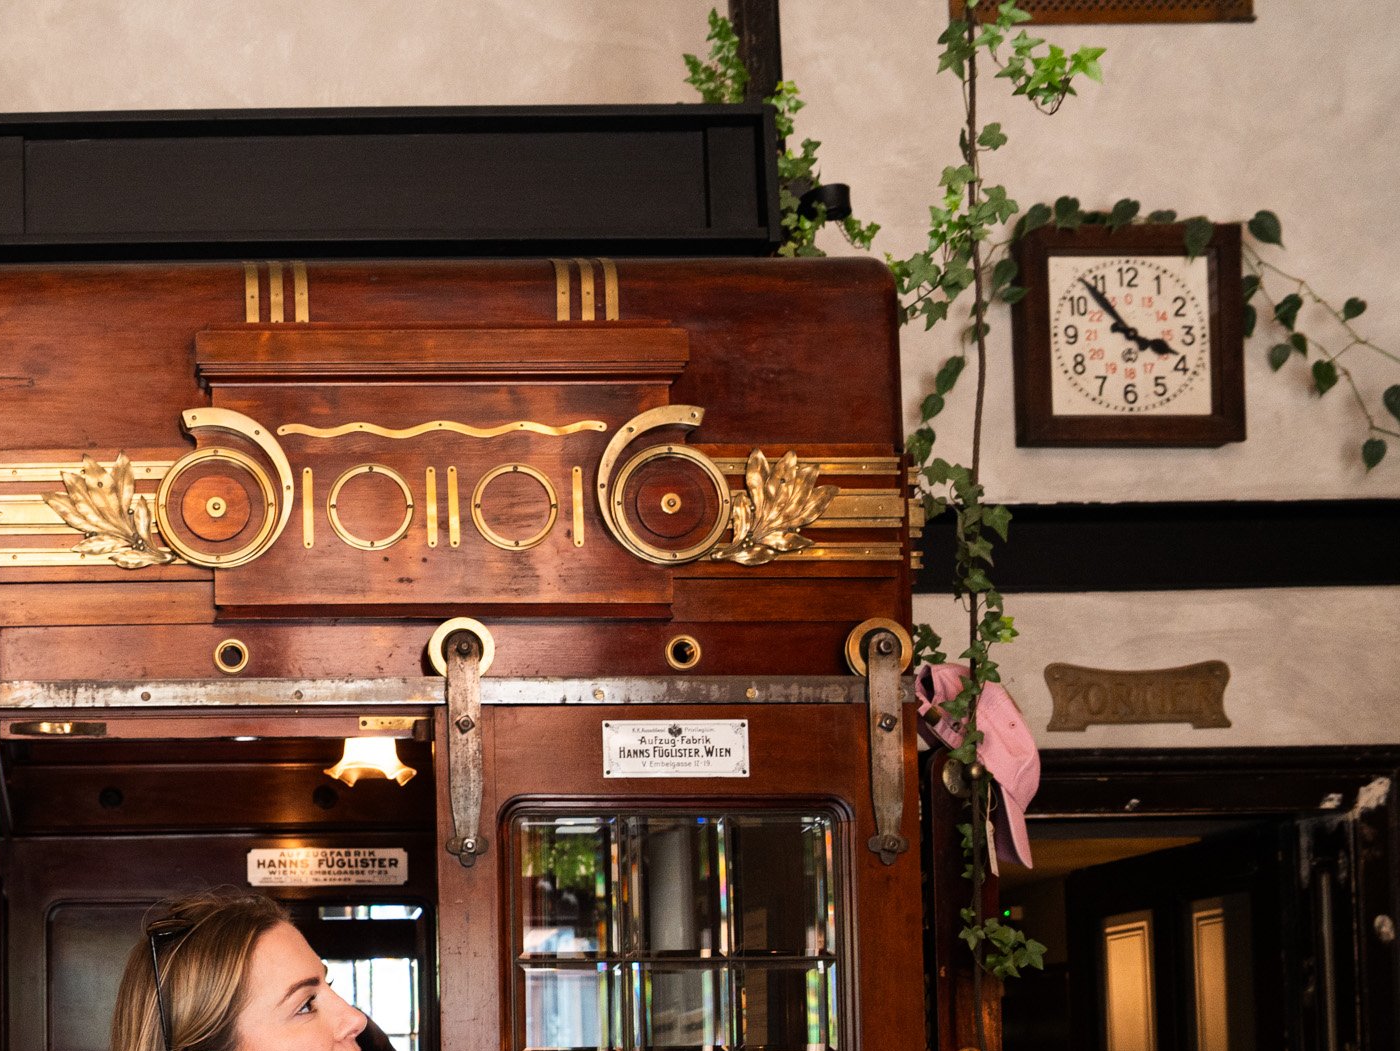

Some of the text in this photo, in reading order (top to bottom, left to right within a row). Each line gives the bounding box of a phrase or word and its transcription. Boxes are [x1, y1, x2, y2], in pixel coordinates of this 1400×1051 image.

[1117, 267, 1138, 288] 12
[1154, 275, 1162, 295] 1
[1069, 296, 1088, 316] 10
[1142, 296, 1154, 307] 13
[1172, 297, 1186, 317] 2
[1089, 310, 1103, 322] 22
[1156, 311, 1168, 322] 14
[1064, 324, 1078, 344] 9
[1085, 330, 1097, 341] 21
[1161, 330, 1174, 341] 15
[1181, 325, 1195, 346] 3
[1089, 348, 1104, 360] 20
[1073, 354, 1086, 375] 8
[1106, 362, 1117, 374] 19
[1143, 363, 1155, 374] 17
[1174, 355, 1189, 374] 4
[1124, 368, 1136, 379] 18
[1094, 376, 1108, 396] 7
[1154, 376, 1167, 397] 5
[1124, 384, 1137, 404] 6
[638, 736, 711, 747] Aufzug-Fabrik
[619, 747, 650, 758] HANNS
[704, 746, 731, 757] WIEN
[257, 857, 399, 868] HANNS FÜGLISTER
